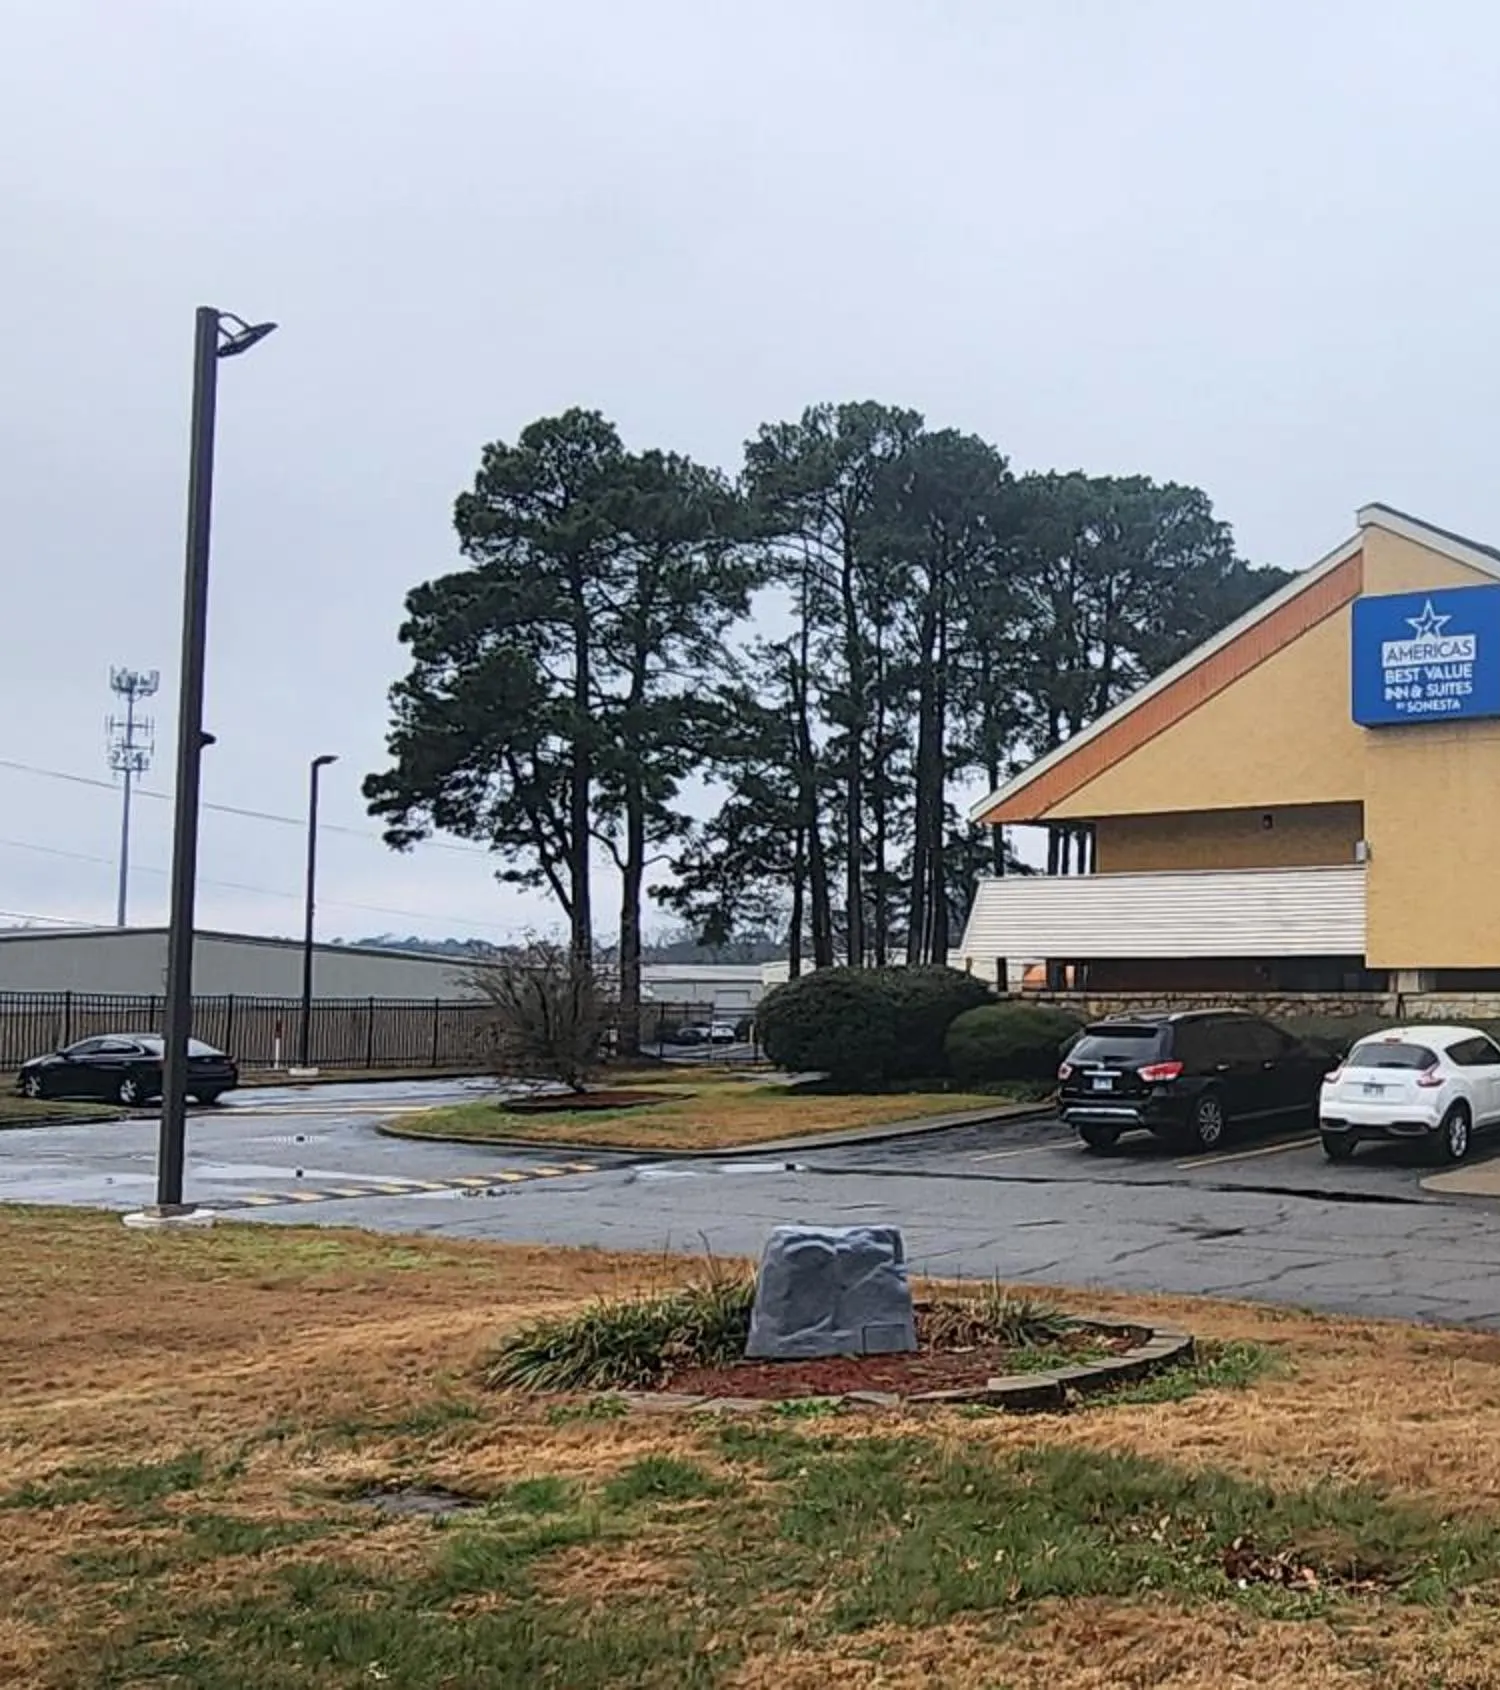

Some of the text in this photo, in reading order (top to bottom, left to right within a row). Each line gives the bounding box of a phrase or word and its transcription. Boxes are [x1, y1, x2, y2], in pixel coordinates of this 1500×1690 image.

[1387, 640, 1472, 662] AMERICAS
[1385, 664, 1472, 684] BEST VALUE
[1385, 682, 1472, 701] INN & SUITES
[1407, 699, 1461, 713] SONESTA
